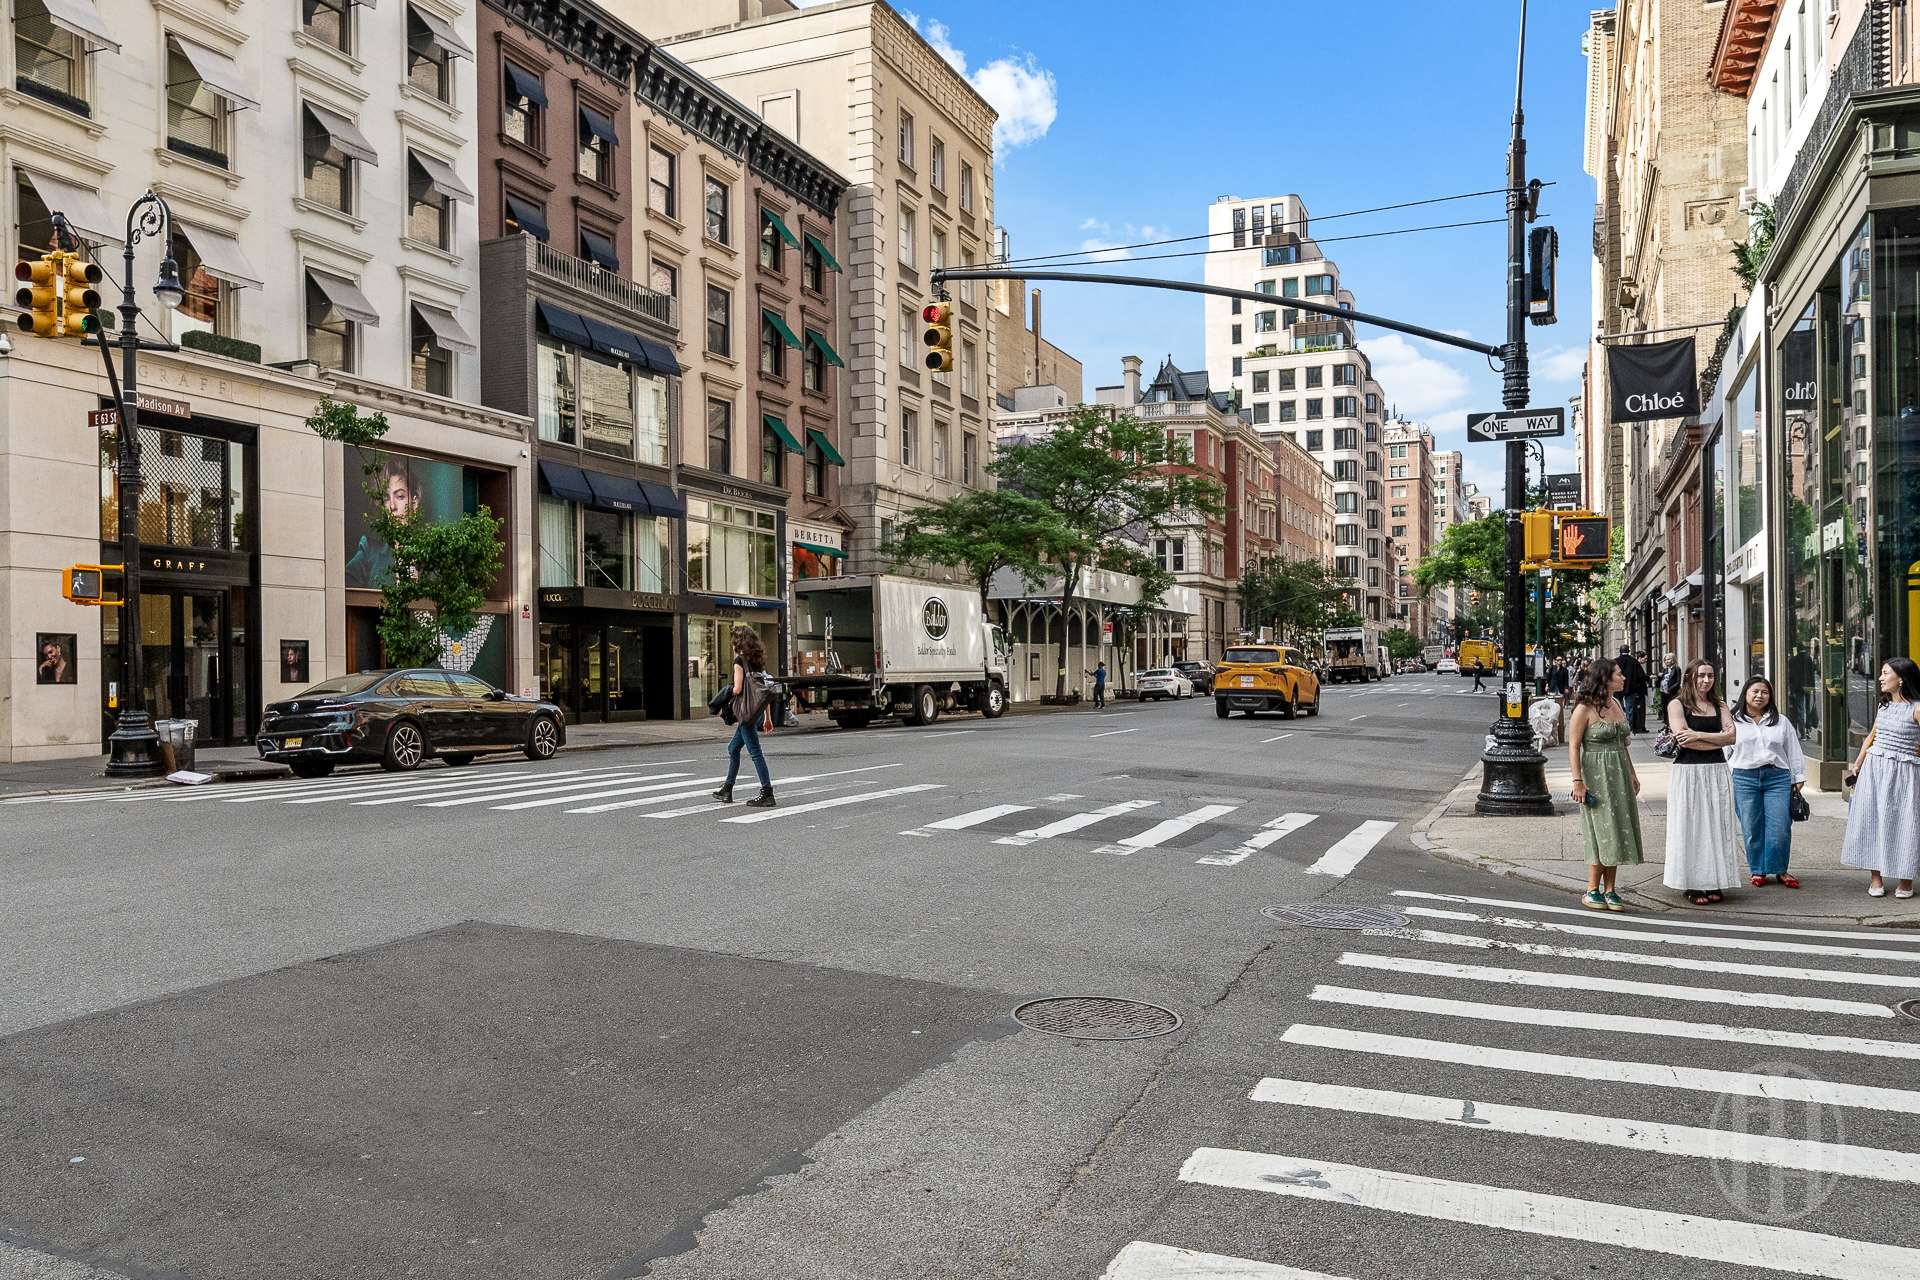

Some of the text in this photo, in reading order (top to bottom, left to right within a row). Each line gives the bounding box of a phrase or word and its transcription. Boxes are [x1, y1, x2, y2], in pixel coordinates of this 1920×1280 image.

[138, 365, 226, 394] GRAFF
[139, 397, 185, 415] Madison Av
[1625, 391, 1685, 413] Chloé
[95, 414, 99, 425] E
[100, 412, 108, 424] 63
[1482, 416, 1554, 432] ONE WAY
[794, 529, 834, 545] BERETTA
[153, 558, 205, 571] GRAFF
